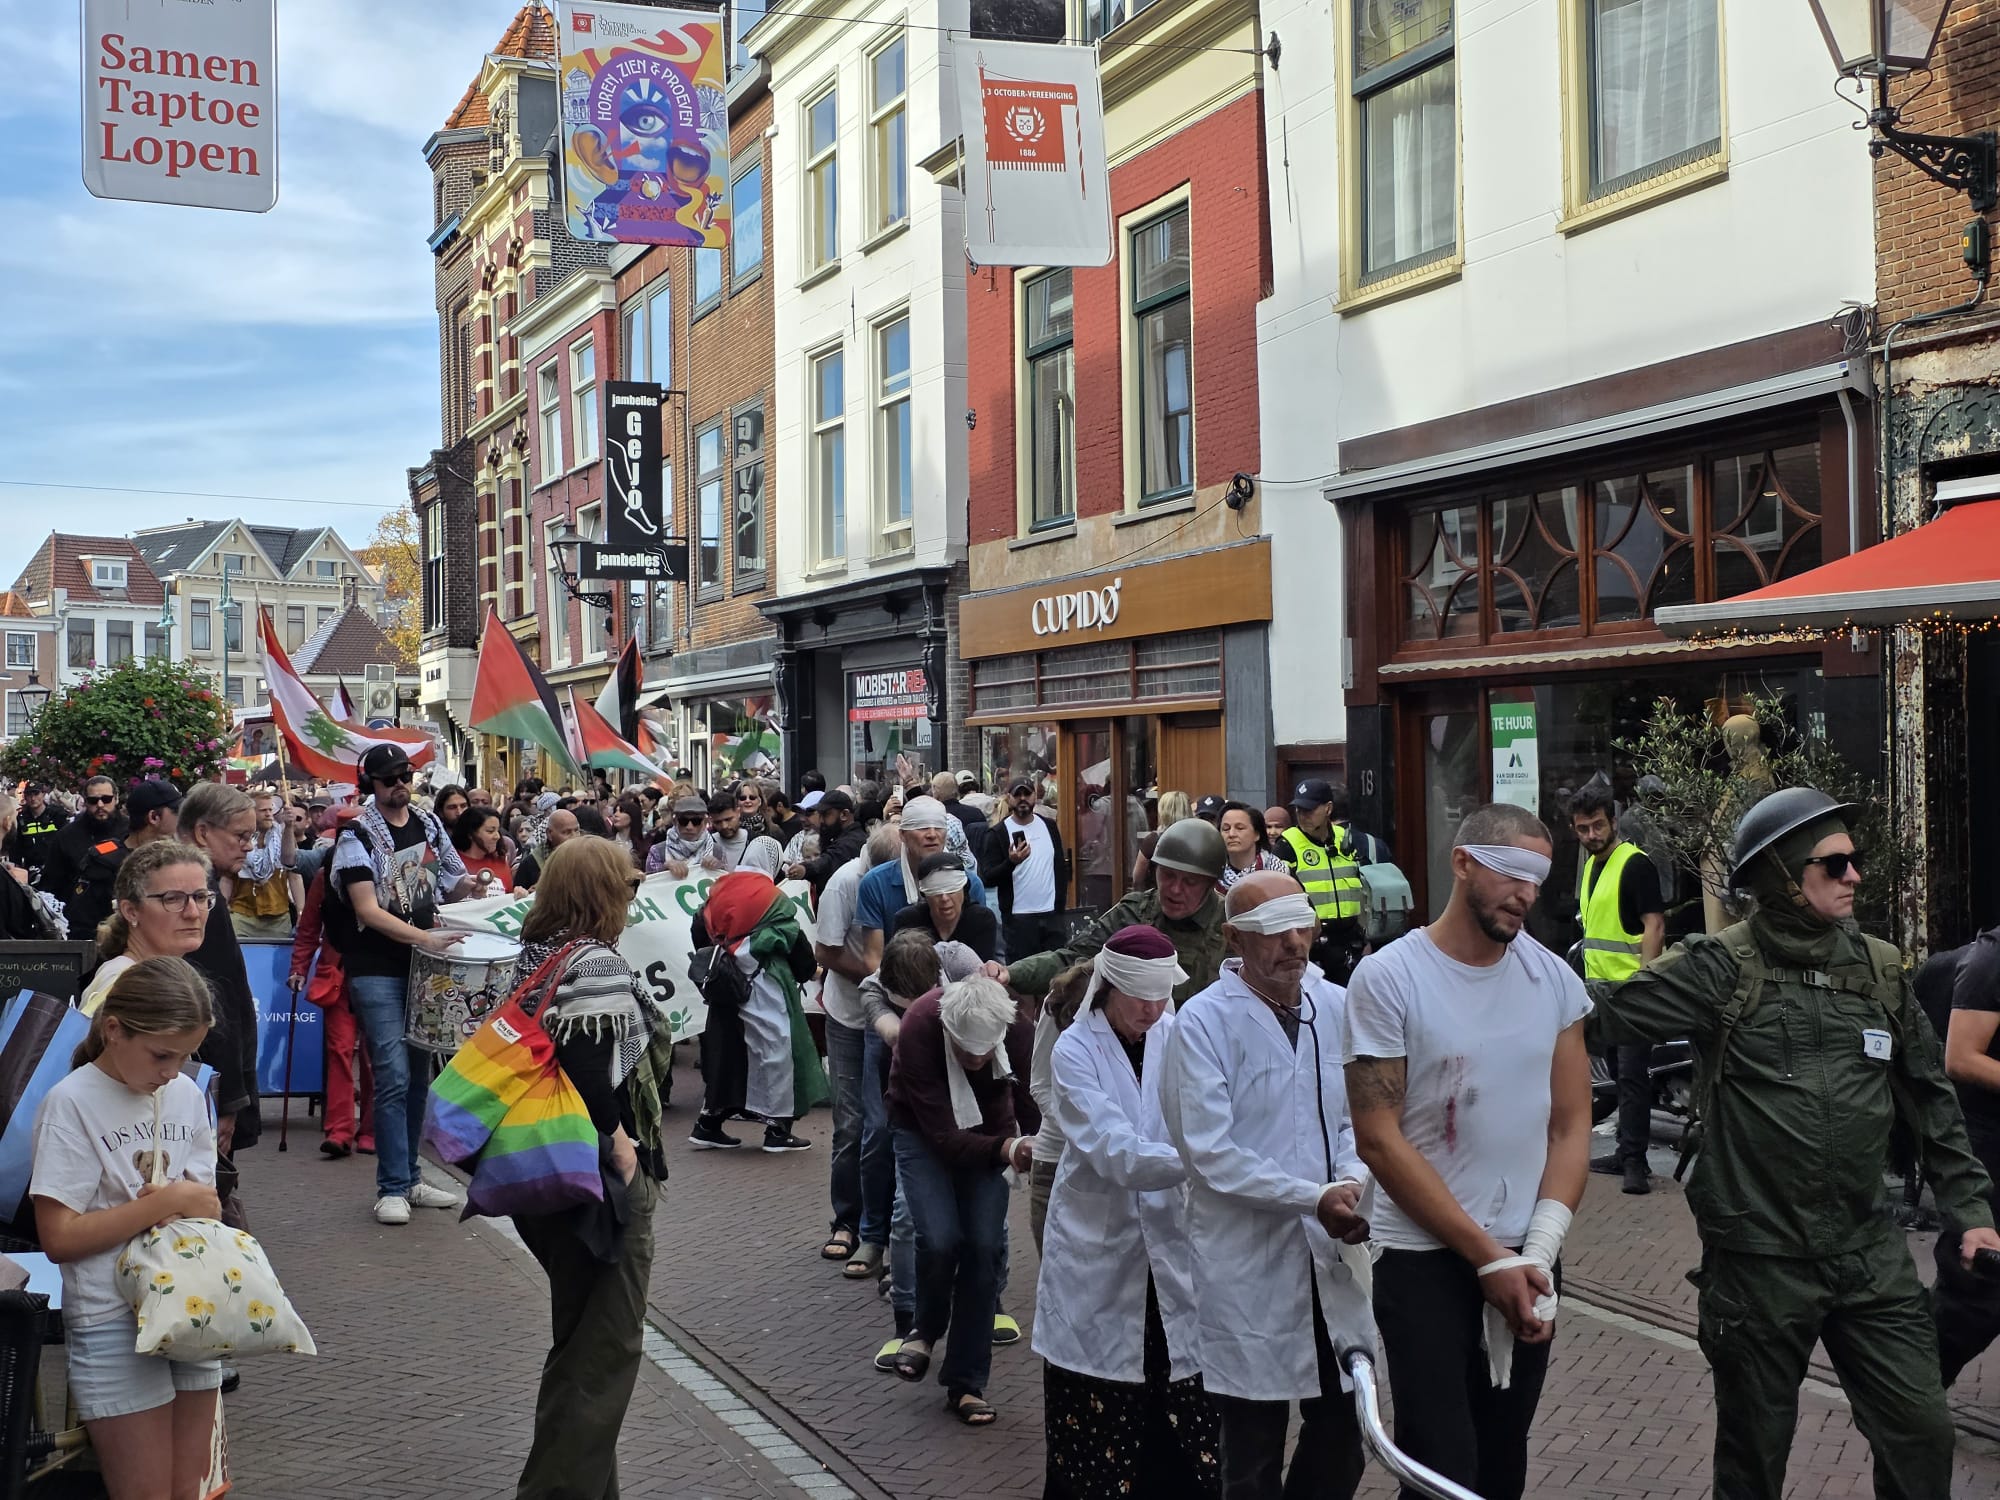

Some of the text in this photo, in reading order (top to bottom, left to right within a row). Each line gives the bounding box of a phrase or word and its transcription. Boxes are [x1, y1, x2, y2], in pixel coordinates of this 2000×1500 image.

[100, 33, 260, 87] Samen
[99, 76, 260, 128] Taptoe
[616, 59, 647, 78] ZIEN
[650, 61, 661, 76] &
[660, 67, 694, 128] PROEVEN
[986, 88, 1074, 101] 3 OCTOBER-VEREENIGING
[100, 121, 261, 178] Lopen
[1019, 148, 1036, 158] 1886
[611, 393, 658, 408] jambelles
[596, 552, 660, 570] jambelles
[1493, 715, 1533, 731] TE HUUR
[1360, 769, 1374, 796] 18
[484, 900, 534, 937] EN
[264, 1012, 317, 1023] VINTAGE
[101, 1122, 195, 1152] LOS ANELE
